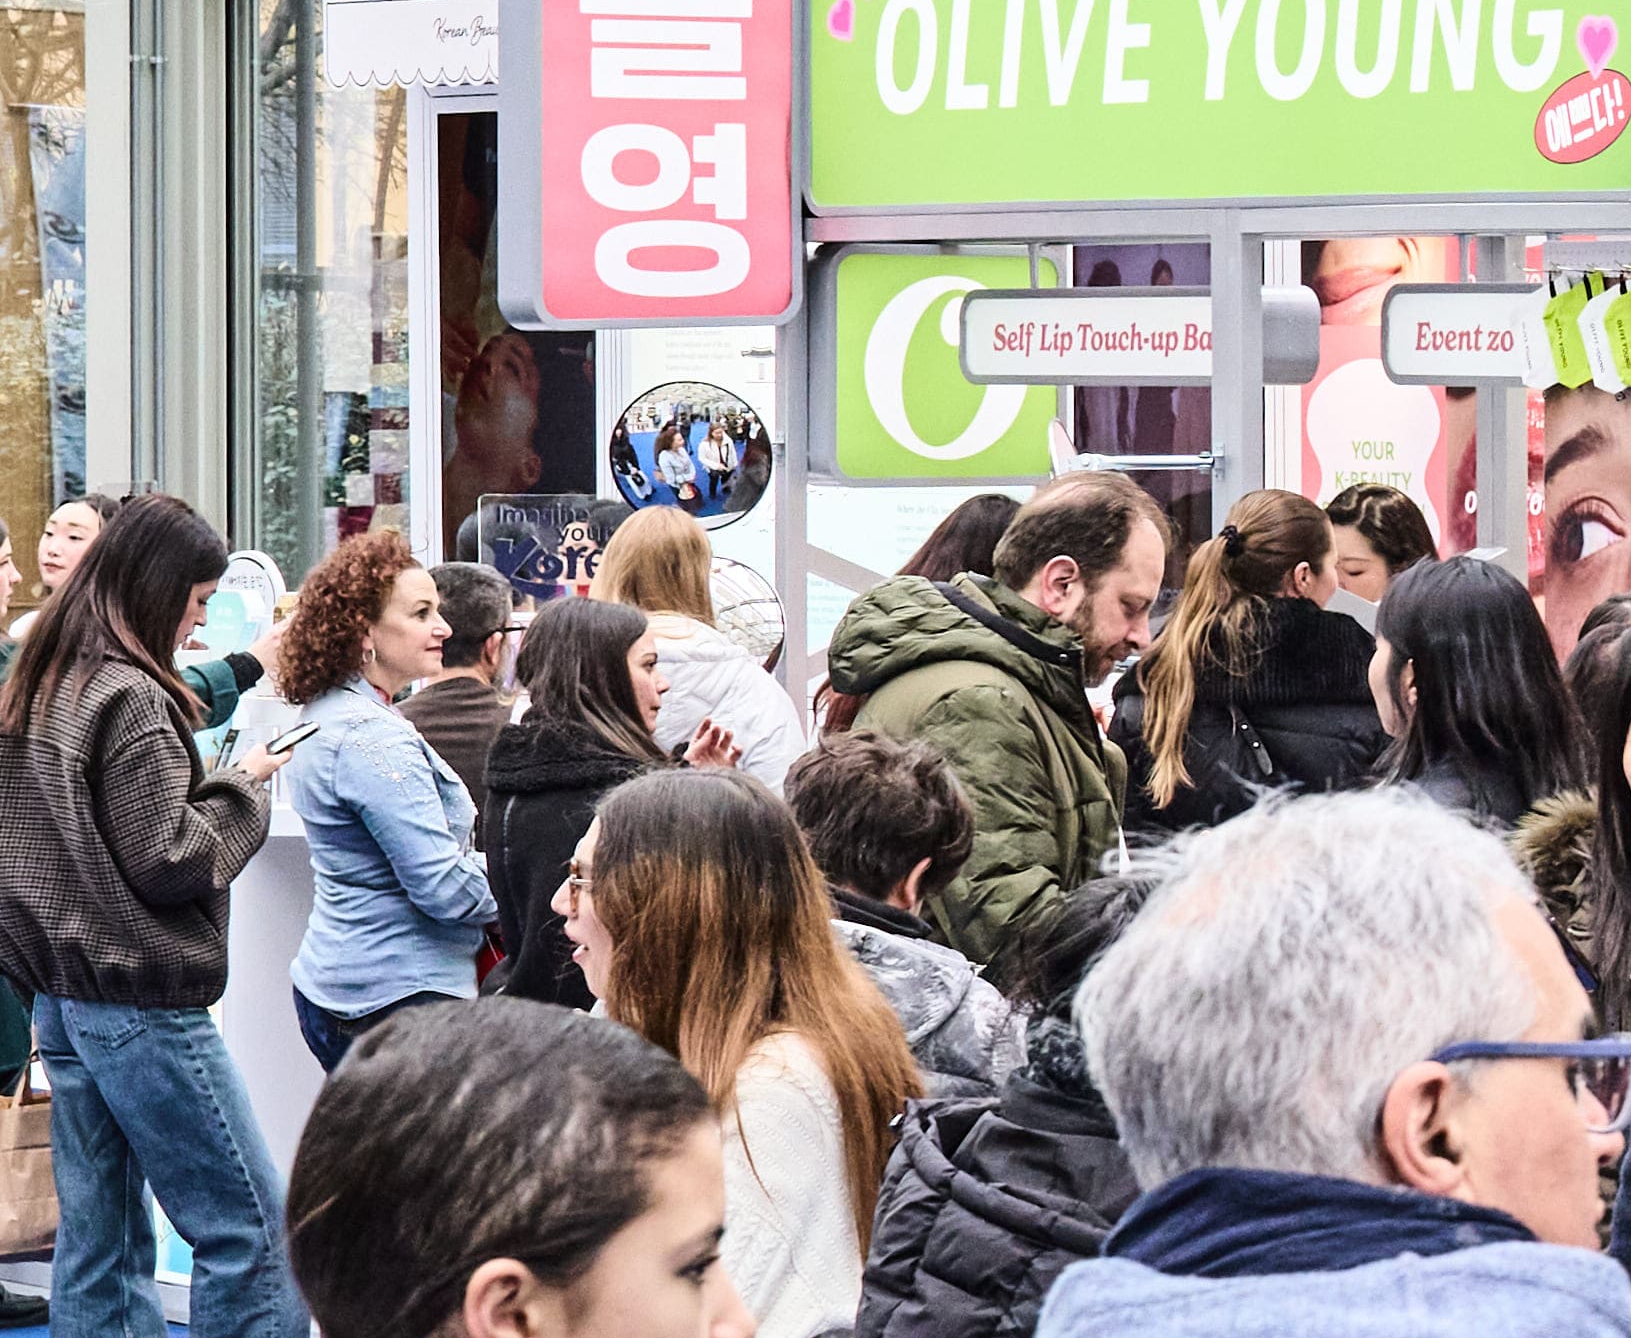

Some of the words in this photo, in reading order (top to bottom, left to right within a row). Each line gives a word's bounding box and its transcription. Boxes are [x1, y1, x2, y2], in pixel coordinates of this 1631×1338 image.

[993, 321, 1033, 357] Self
[1038, 322, 1073, 363] Lip
[1077, 321, 1178, 360] Touch-up
[1416, 322, 1483, 352] Event
[1352, 440, 1395, 461] YOUR
